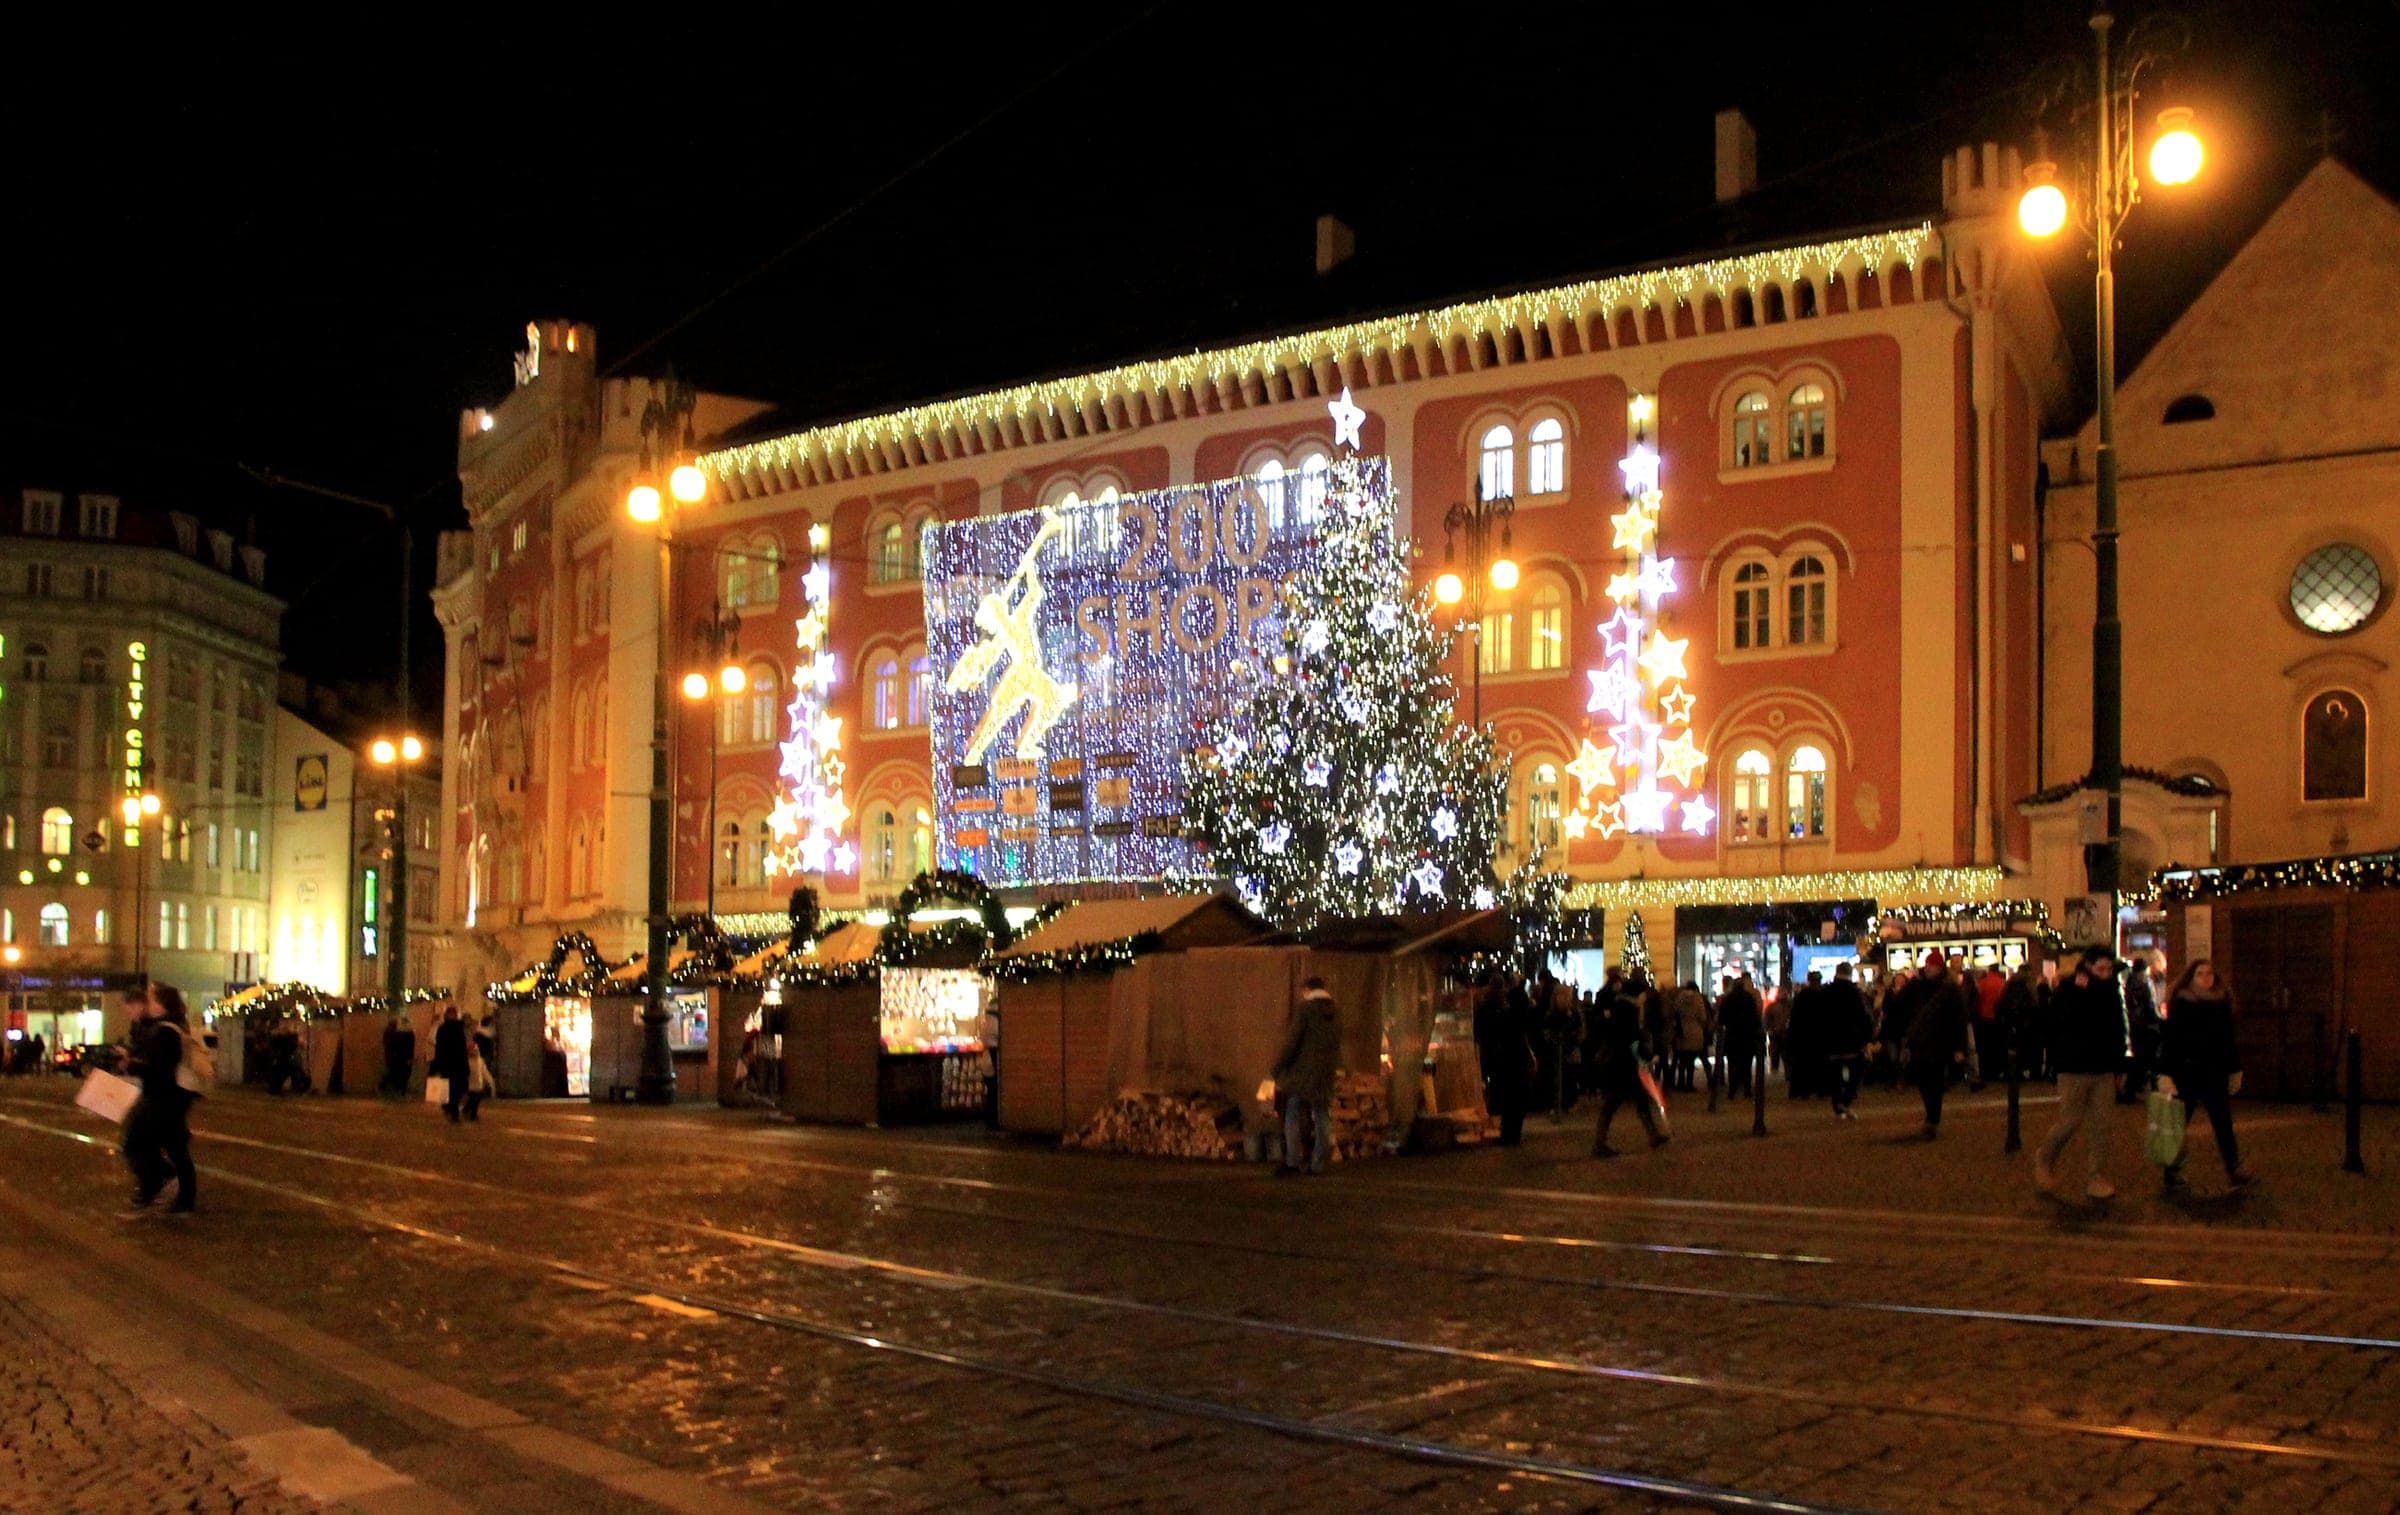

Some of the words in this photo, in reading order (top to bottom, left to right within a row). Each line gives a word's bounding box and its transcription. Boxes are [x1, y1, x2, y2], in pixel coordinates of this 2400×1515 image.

[1116, 486, 1271, 581] 200
[1078, 570, 1298, 663] SHOP
[126, 641, 147, 720] CITY
[124, 728, 144, 847] CENR
[999, 760, 1035, 769] URBAN
